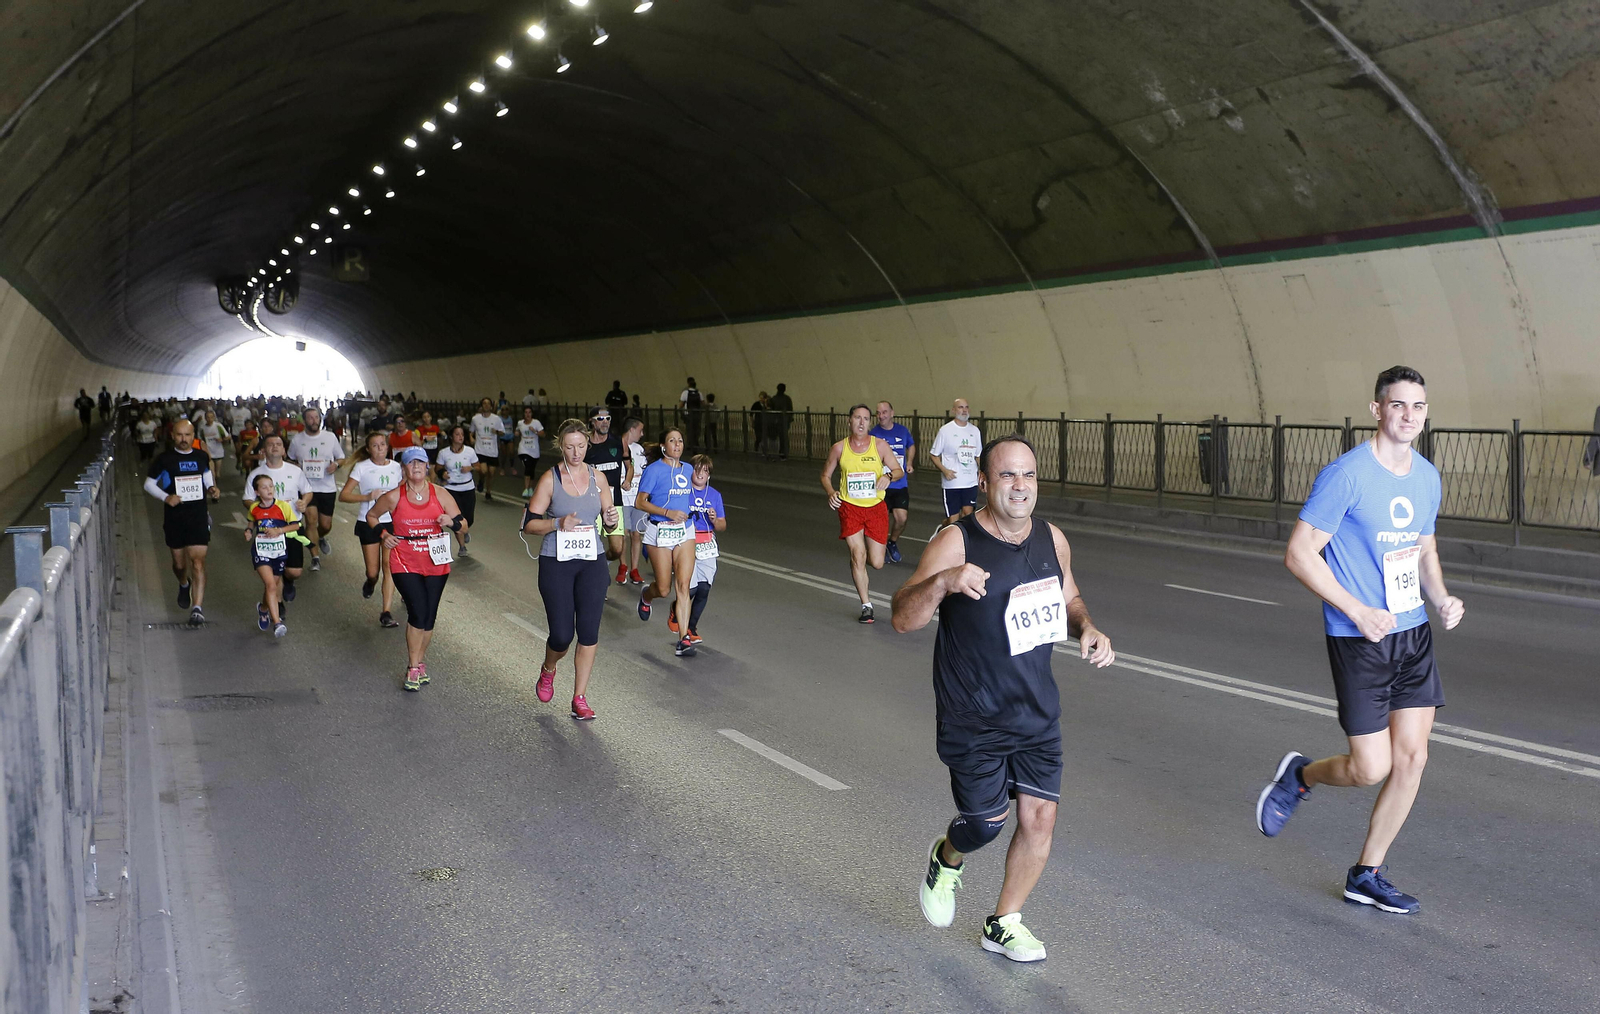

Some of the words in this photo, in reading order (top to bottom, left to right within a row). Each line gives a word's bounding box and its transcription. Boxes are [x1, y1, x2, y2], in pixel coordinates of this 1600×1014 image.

[181, 485, 199, 493] 3682
[849, 481, 874, 491] 20137
[659, 529, 684, 538] 23867
[564, 539, 591, 549] 2882
[1011, 602, 1060, 630] 18137
